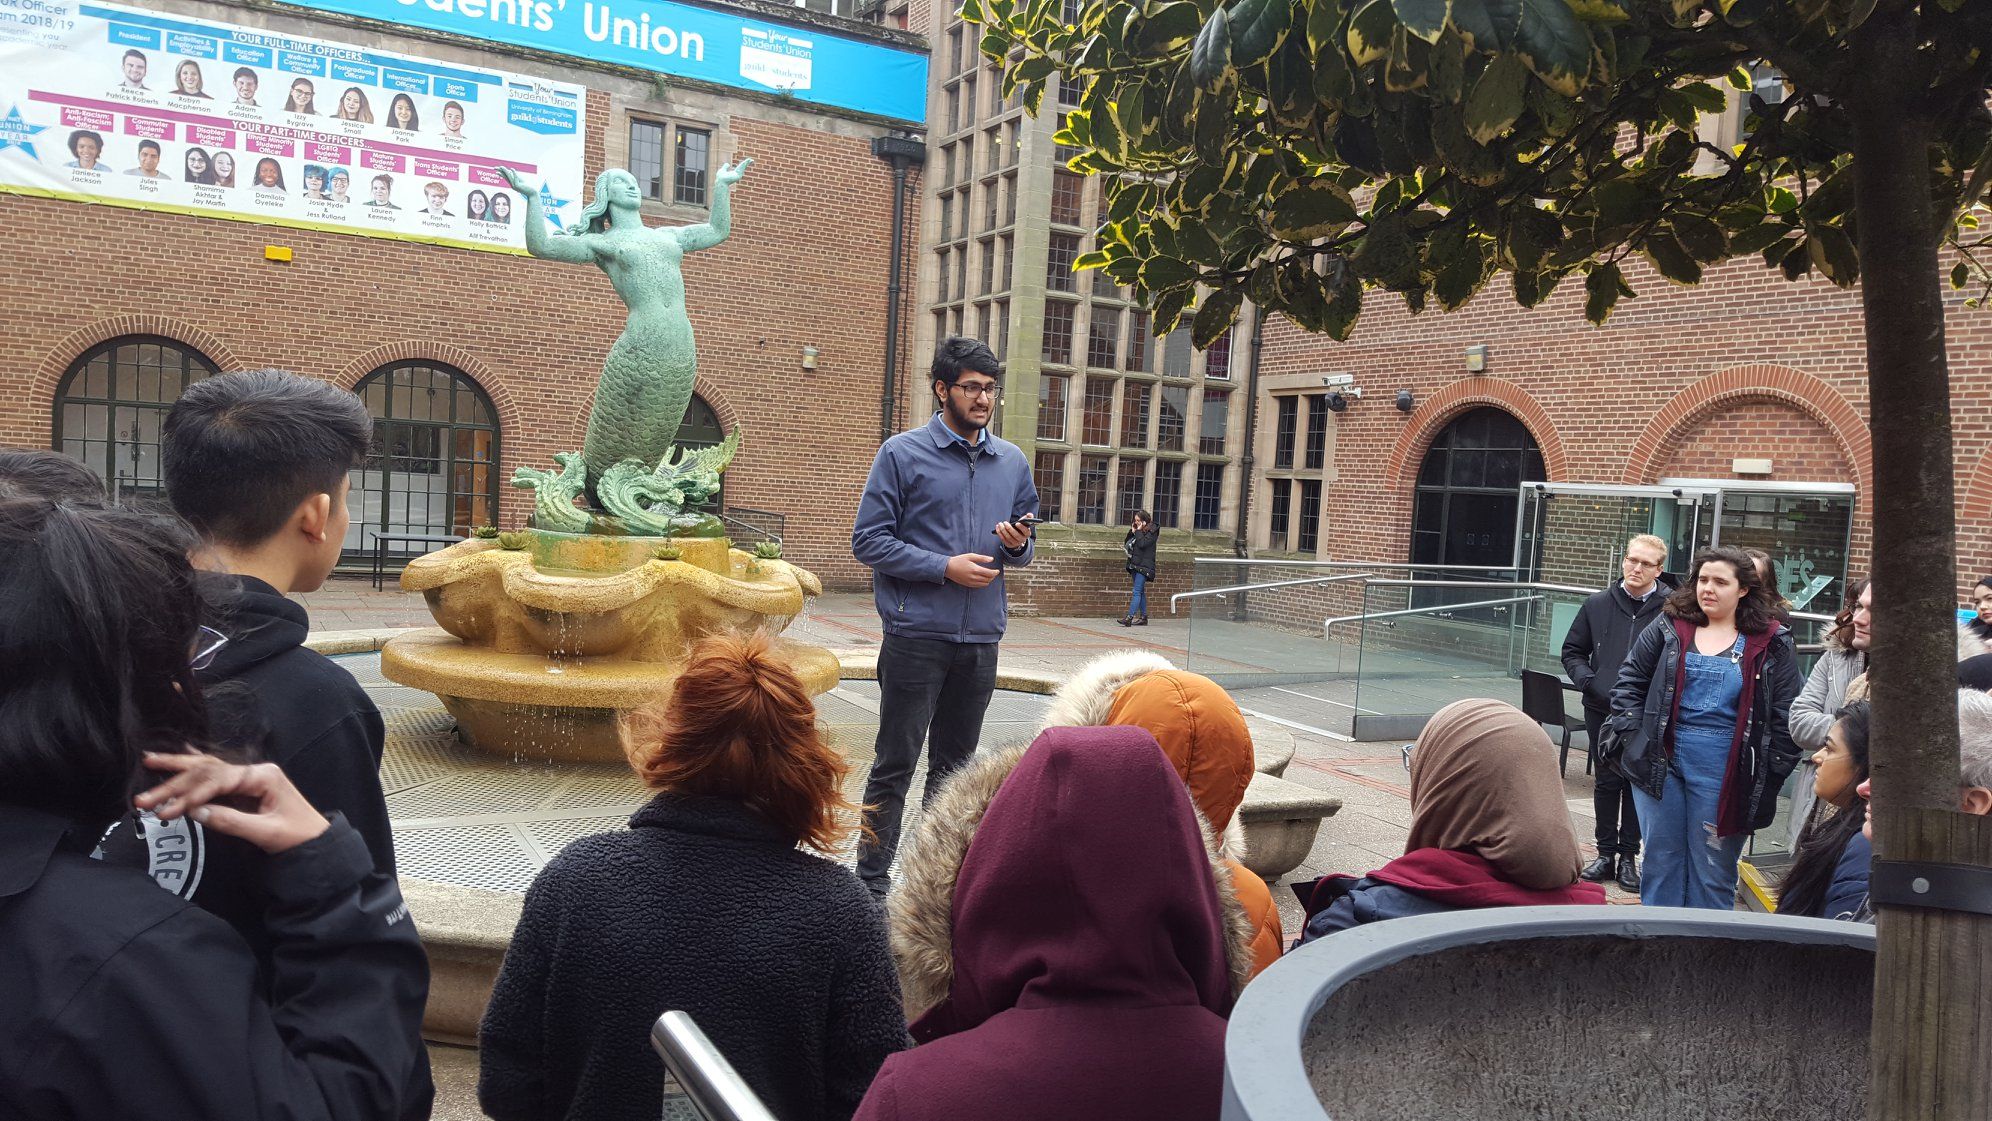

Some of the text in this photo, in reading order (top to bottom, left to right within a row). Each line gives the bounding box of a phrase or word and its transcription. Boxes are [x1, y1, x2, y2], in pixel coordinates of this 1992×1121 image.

[22, 0, 67, 15] Officer
[21, 13, 74, 30] 2018/19
[395, 0, 704, 61] ents' Union
[118, 31, 151, 42] President
[174, 34, 202, 45] Activities
[169, 39, 215, 53] Employability
[231, 32, 261, 45] YOUR
[264, 37, 313, 53] FULL-TIME
[180, 47, 203, 57] Officer
[231, 46, 265, 58] Education
[786, 45, 812, 59] Union
[236, 53, 259, 63] Officer
[287, 53, 311, 62] Welfare
[283, 59, 320, 70] Community
[290, 66, 313, 75] Officer
[333, 63, 376, 76] Postgraduate
[343, 71, 366, 80] Officer
[386, 73, 426, 85] International
[395, 80, 417, 89] Officer
[446, 82, 465, 92] Sports
[121, 87, 144, 96] Reece
[445, 88, 466, 97] Officer
[106, 92, 131, 101] Patrick
[167, 101, 211, 113] Macpherson
[551, 97, 577, 108] Union
[235, 105, 257, 113] Adam
[228, 110, 263, 121] Goldstone
[131, 117, 169, 128] Commuter
[286, 119, 314, 128] Bygrave
[341, 120, 365, 129] Jessica
[137, 130, 162, 139] Officer
[196, 127, 226, 136] Disabled
[232, 120, 262, 131] YOUR
[264, 125, 316, 141] PART-TIME
[343, 126, 362, 135] Small
[391, 129, 415, 137] Joanne
[199, 139, 223, 148] Officer
[268, 136, 294, 146] Minority
[444, 136, 464, 145] Simon
[258, 147, 282, 155] Officer
[445, 143, 461, 151] Price
[316, 156, 339, 164] Officer
[372, 152, 394, 160] Mature
[372, 163, 394, 172] Officer
[72, 168, 101, 177] Janiece
[426, 168, 448, 177] Officer
[476, 170, 504, 179] Women
[71, 175, 102, 185] Jackson
[140, 177, 158, 186] Jules
[480, 176, 500, 184] Officer
[139, 184, 159, 192] Singh
[193, 185, 225, 194] Shamima
[195, 191, 217, 200] Akhtar
[255, 192, 285, 201] Damilola
[192, 198, 226, 207] Jay Martin
[254, 199, 284, 208] Oyeleke
[309, 199, 344, 209] Josie Hyde
[371, 207, 393, 215] Lauren
[321, 213, 346, 221] Rutland
[367, 213, 396, 223] Kennedy
[422, 220, 451, 229] Humphris
[469, 220, 485, 228] Holly
